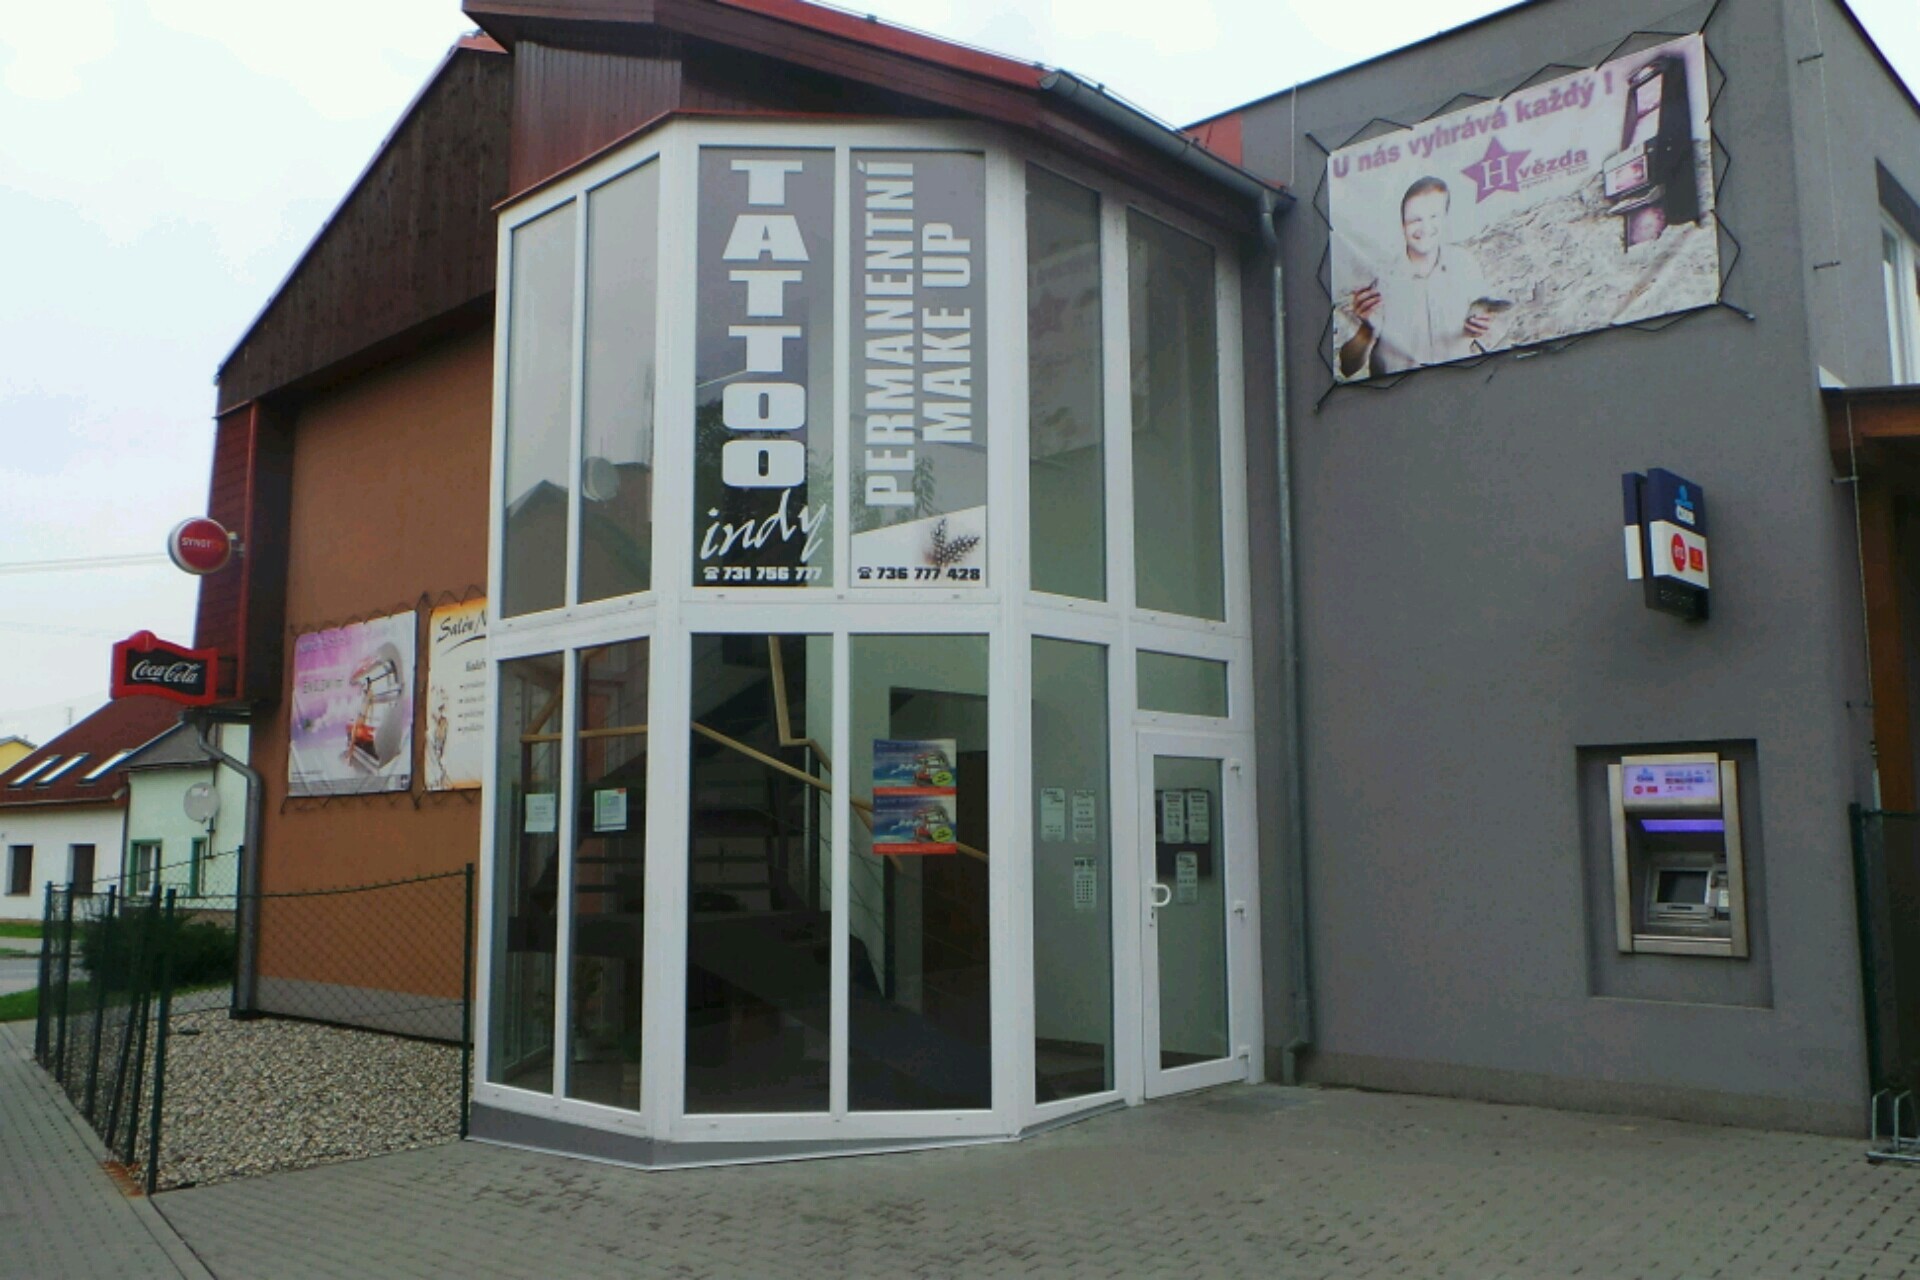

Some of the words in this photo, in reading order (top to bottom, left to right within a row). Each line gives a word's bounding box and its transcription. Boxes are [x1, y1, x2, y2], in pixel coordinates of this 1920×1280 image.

[1333, 155, 1350, 179] U
[1358, 144, 1401, 172] nás
[1408, 105, 1509, 159] vyhrává
[1515, 77, 1595, 123] každý
[923, 222, 971, 287] UP
[722, 160, 810, 488] TATTOO
[857, 160, 914, 506] PERMANENTNÍ
[923, 307, 972, 443] MAKE
[700, 488, 826, 562] indy
[722, 566, 751, 580] 731
[795, 566, 823, 580] 777
[877, 567, 908, 580] 736
[914, 567, 941, 580] 777
[946, 568, 981, 580] 428
[131, 659, 201, 684] Coca-Cola
